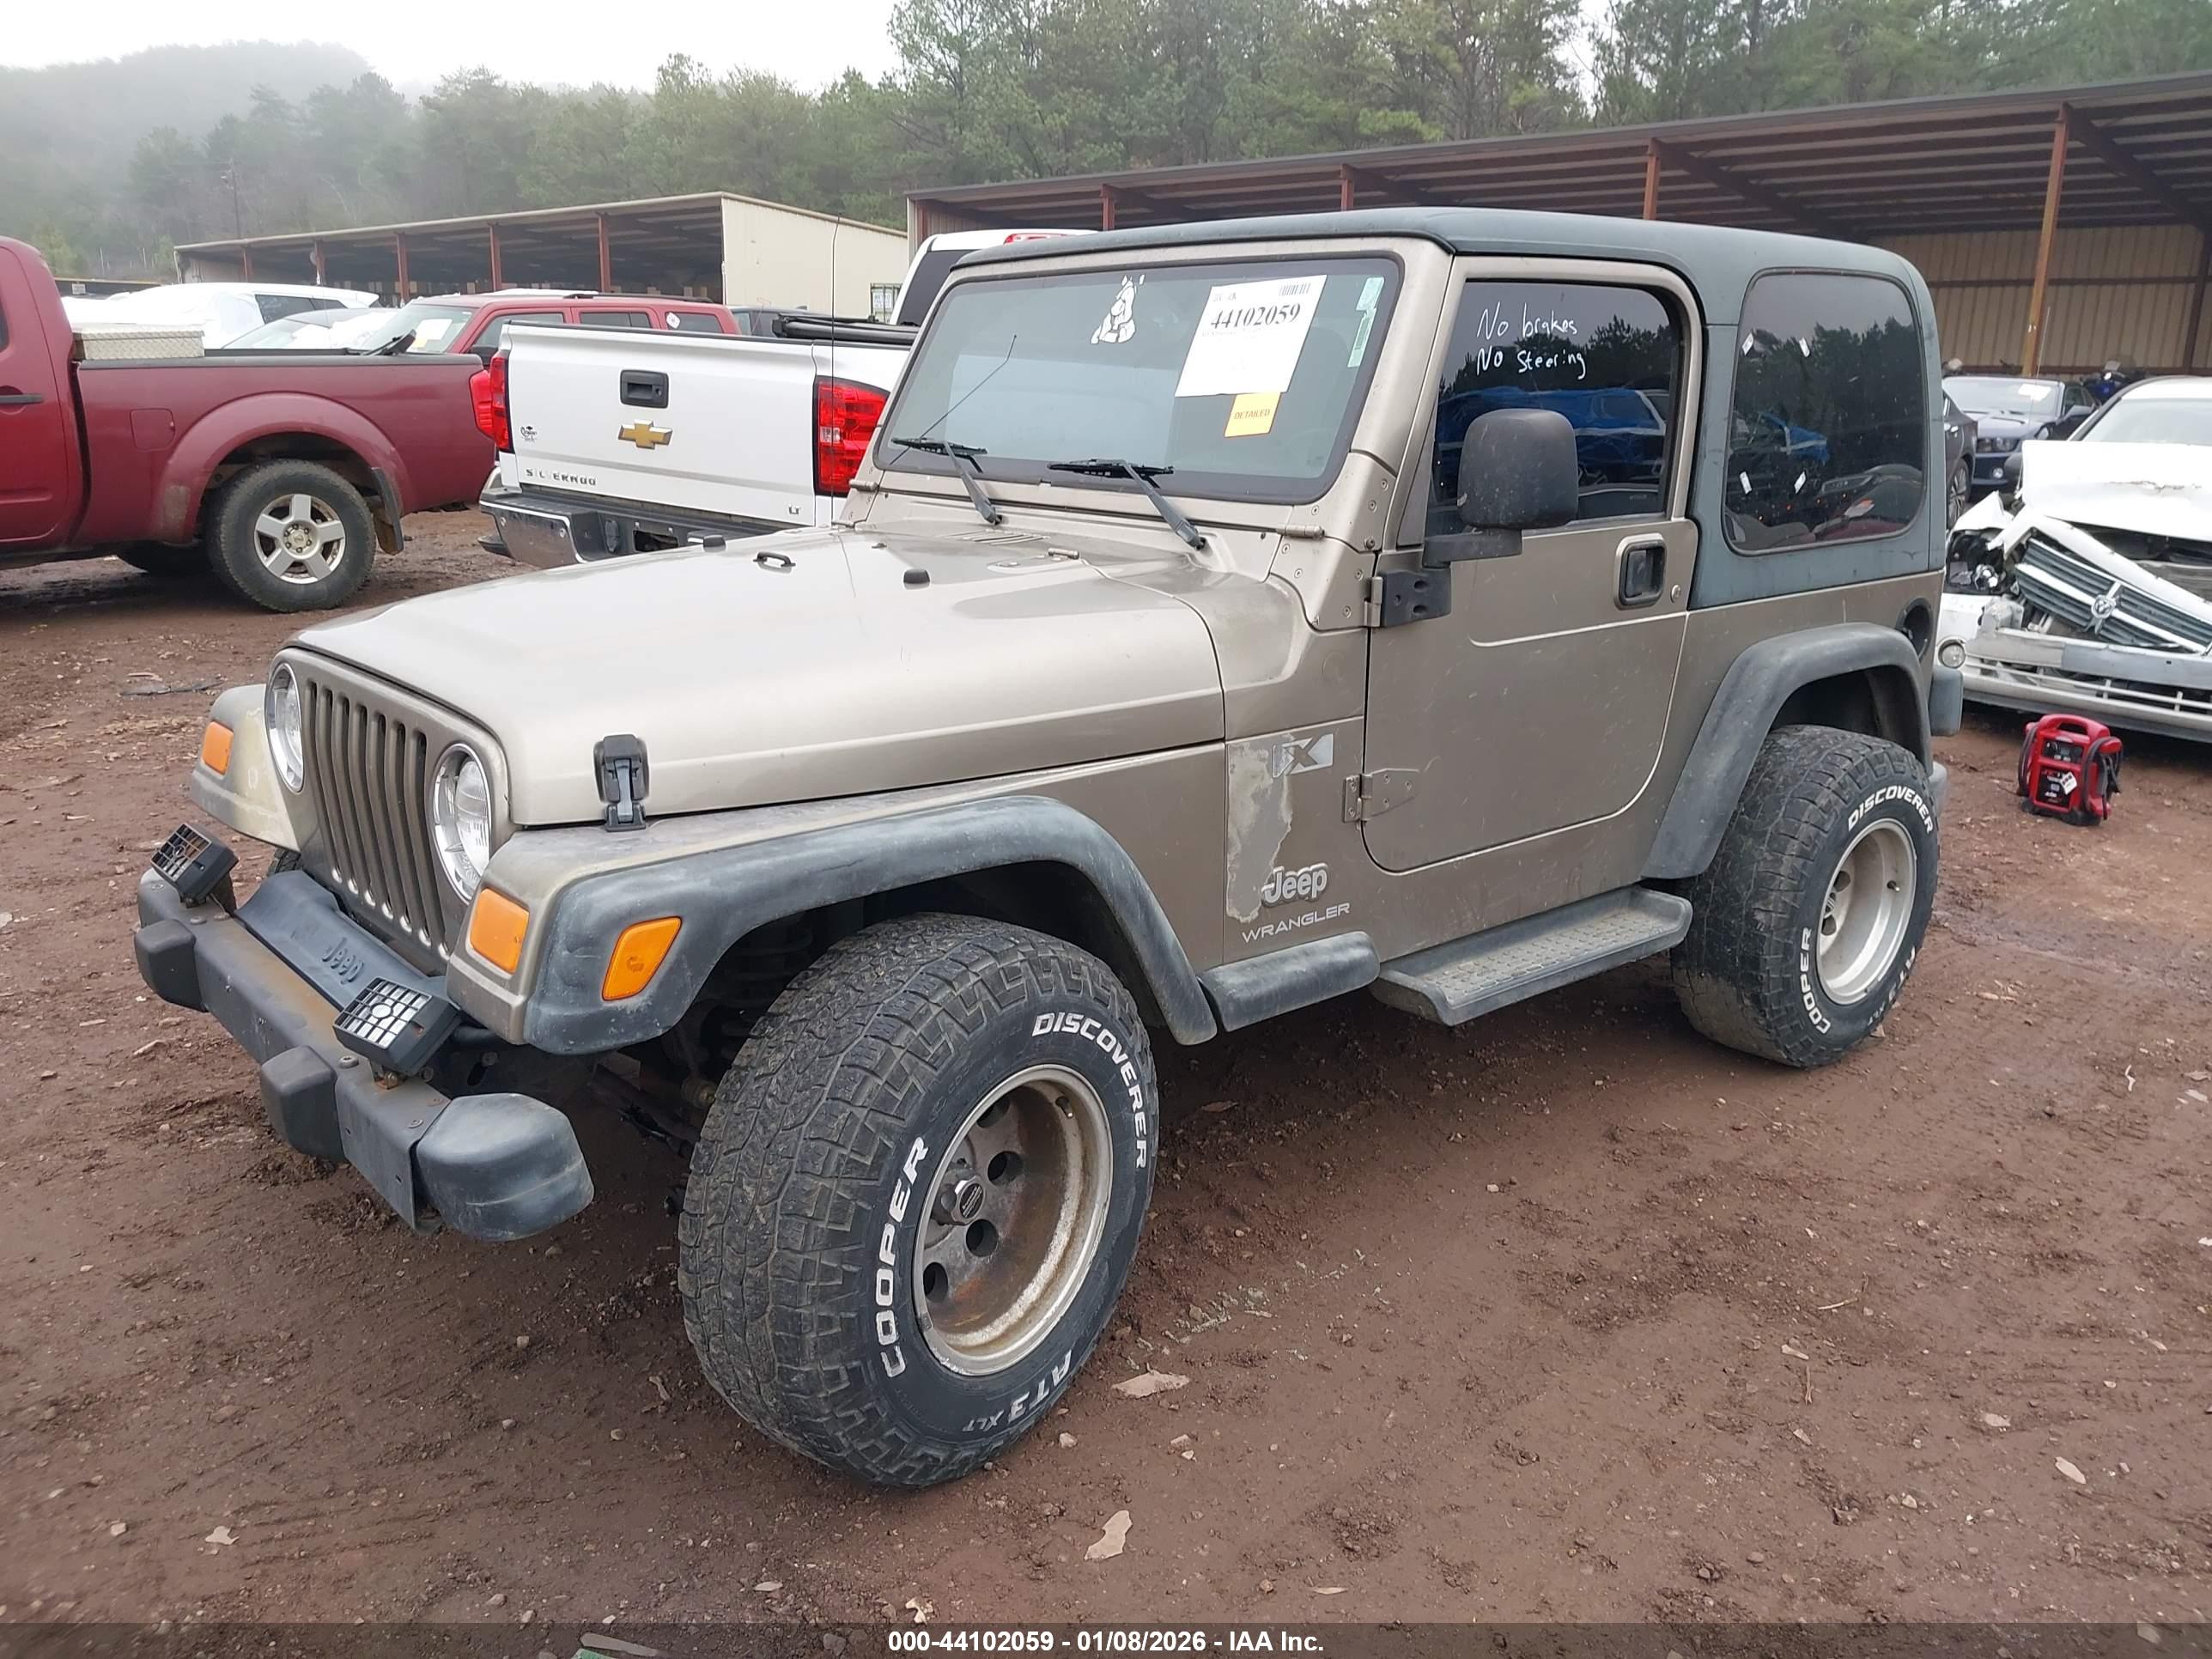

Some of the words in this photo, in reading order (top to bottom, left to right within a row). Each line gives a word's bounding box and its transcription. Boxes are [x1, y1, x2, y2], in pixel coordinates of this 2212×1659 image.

[1210, 302, 1302, 330] 44102059
[1476, 301, 1510, 340] No
[1522, 301, 1578, 338] brakes
[1233, 408, 1272, 420] DETAILED
[1847, 784, 1934, 835] DISCOVERER
[1261, 861, 1329, 908] Jeep
[1241, 902, 1351, 944] WRANGLER
[321, 937, 365, 985] Jeep
[1798, 927, 1832, 1035] COOPER
[1030, 1010, 1149, 1170] DISCOVERER
[873, 1134, 928, 1378] COOPER
[1008, 1349, 1073, 1424] AT3
[962, 1409, 1004, 1432] XLT
